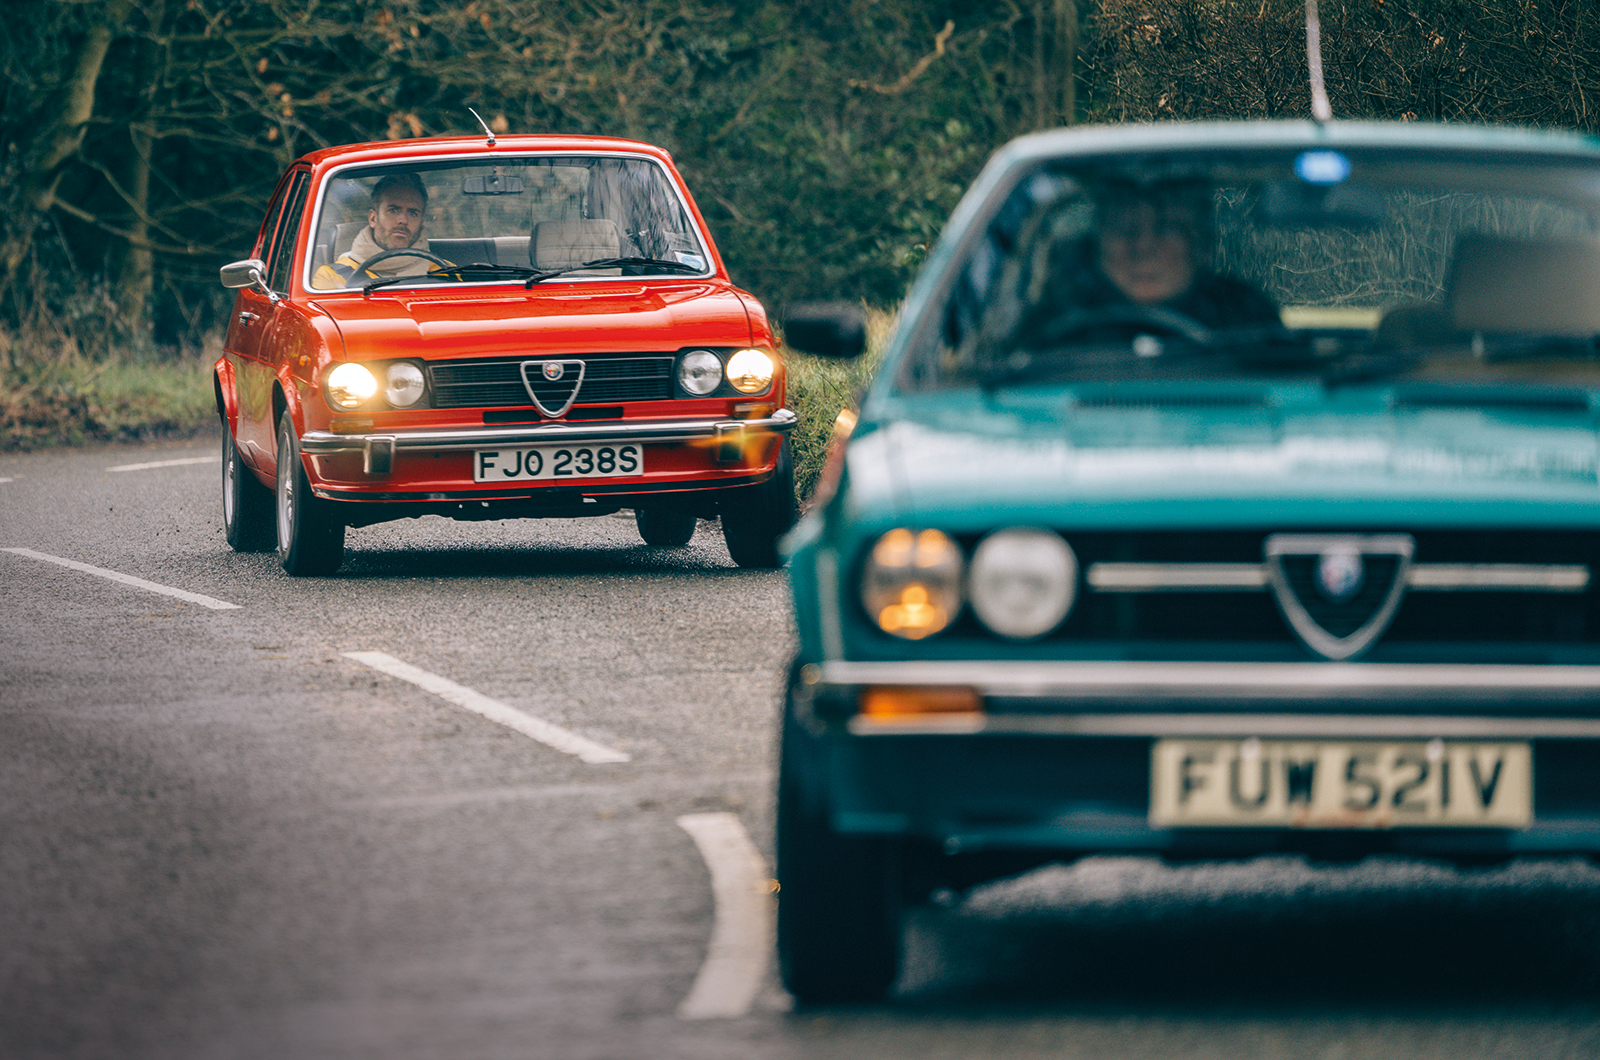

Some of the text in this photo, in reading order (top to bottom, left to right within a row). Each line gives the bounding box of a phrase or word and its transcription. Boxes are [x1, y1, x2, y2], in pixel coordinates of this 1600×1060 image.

[479, 446, 638, 479] FJO 238S
[1179, 753, 1504, 812] FUW 521V
